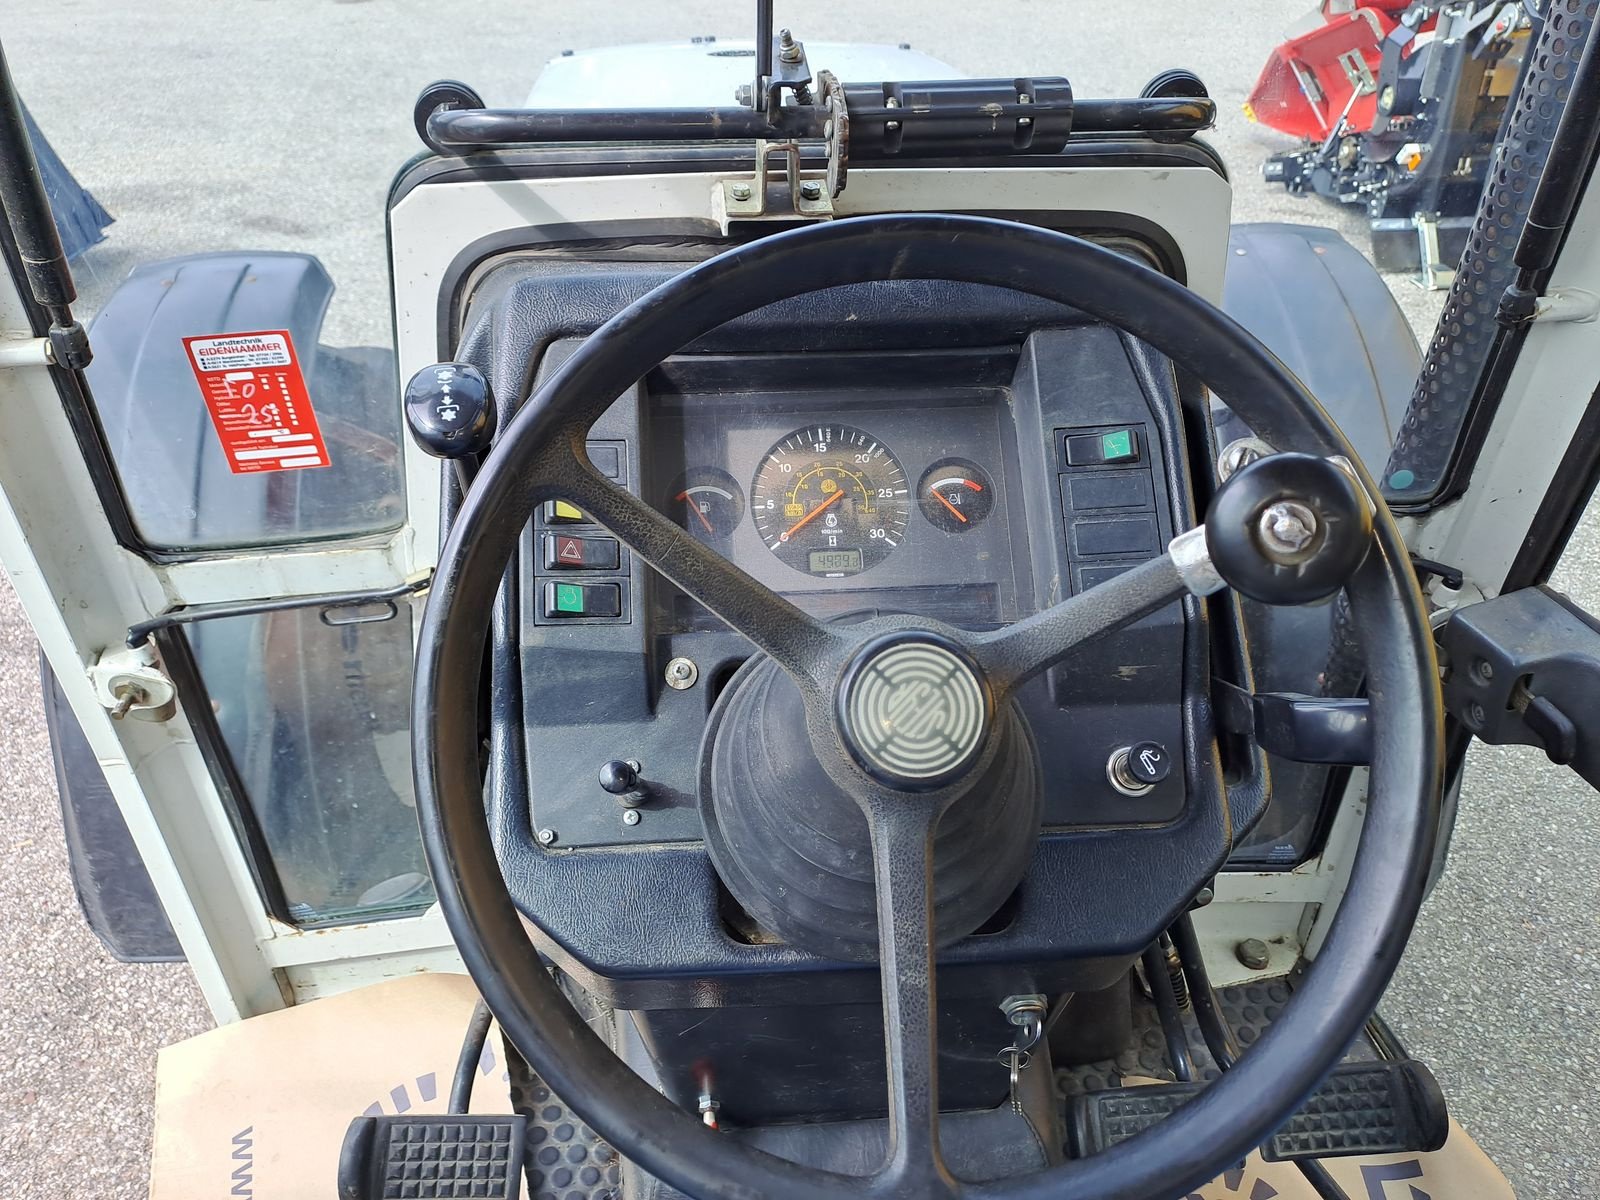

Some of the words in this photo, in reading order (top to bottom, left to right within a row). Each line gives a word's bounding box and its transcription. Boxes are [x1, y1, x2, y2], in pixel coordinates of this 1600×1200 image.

[212, 338, 263, 347] Landtechnik
[198, 343, 282, 356] EIDENHAMMER
[813, 443, 826, 452] 15
[855, 454, 869, 463] 20
[779, 464, 792, 472] 10
[878, 489, 893, 498] 25
[767, 500, 775, 509] 5
[869, 529, 885, 538] 30
